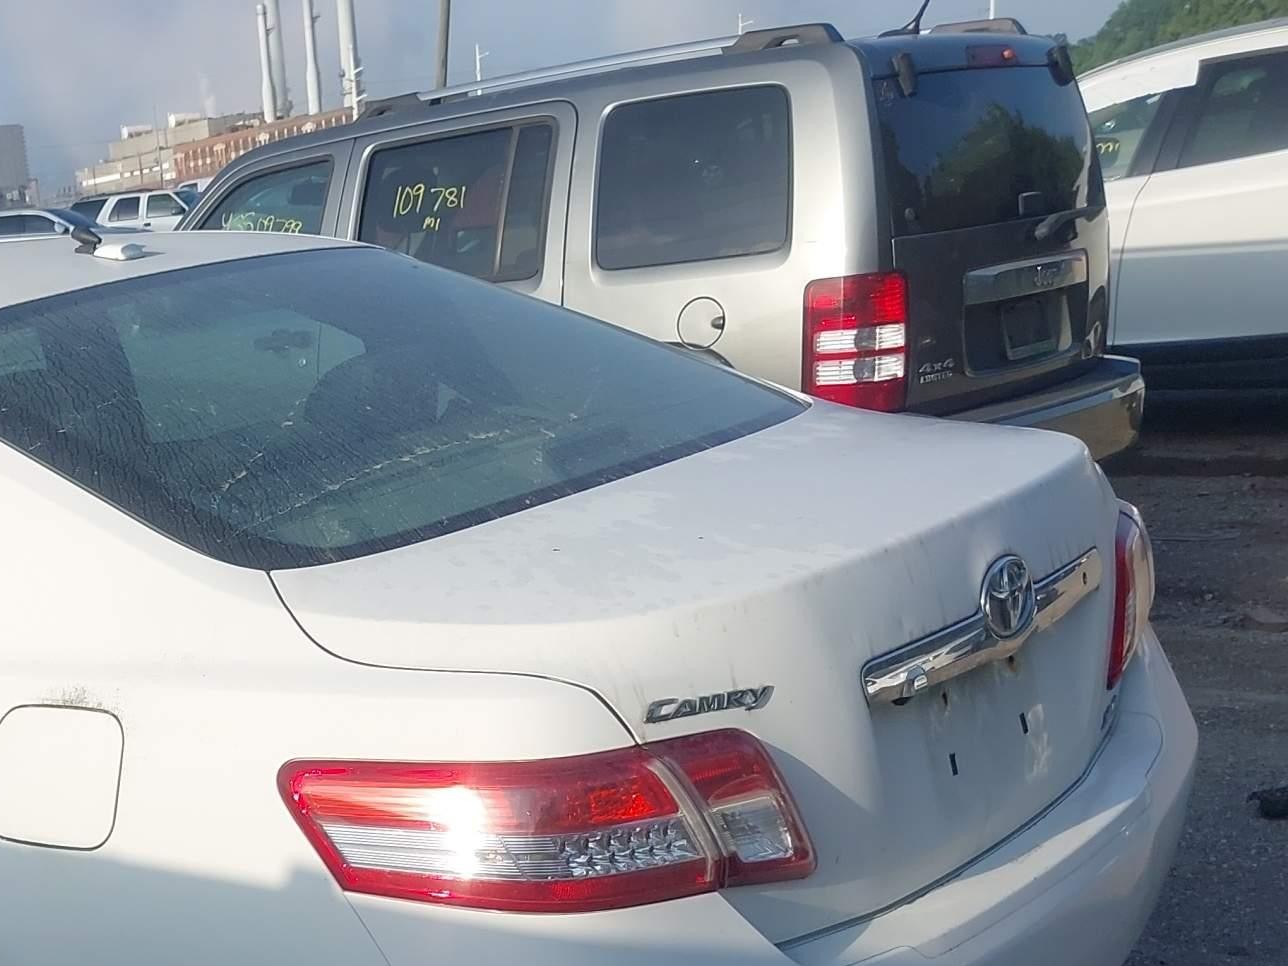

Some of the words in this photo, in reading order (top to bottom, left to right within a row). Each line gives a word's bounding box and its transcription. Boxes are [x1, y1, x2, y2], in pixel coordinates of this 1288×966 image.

[393, 183, 425, 218] 109
[430, 185, 466, 212] 781
[643, 684, 775, 724] CAMRY
